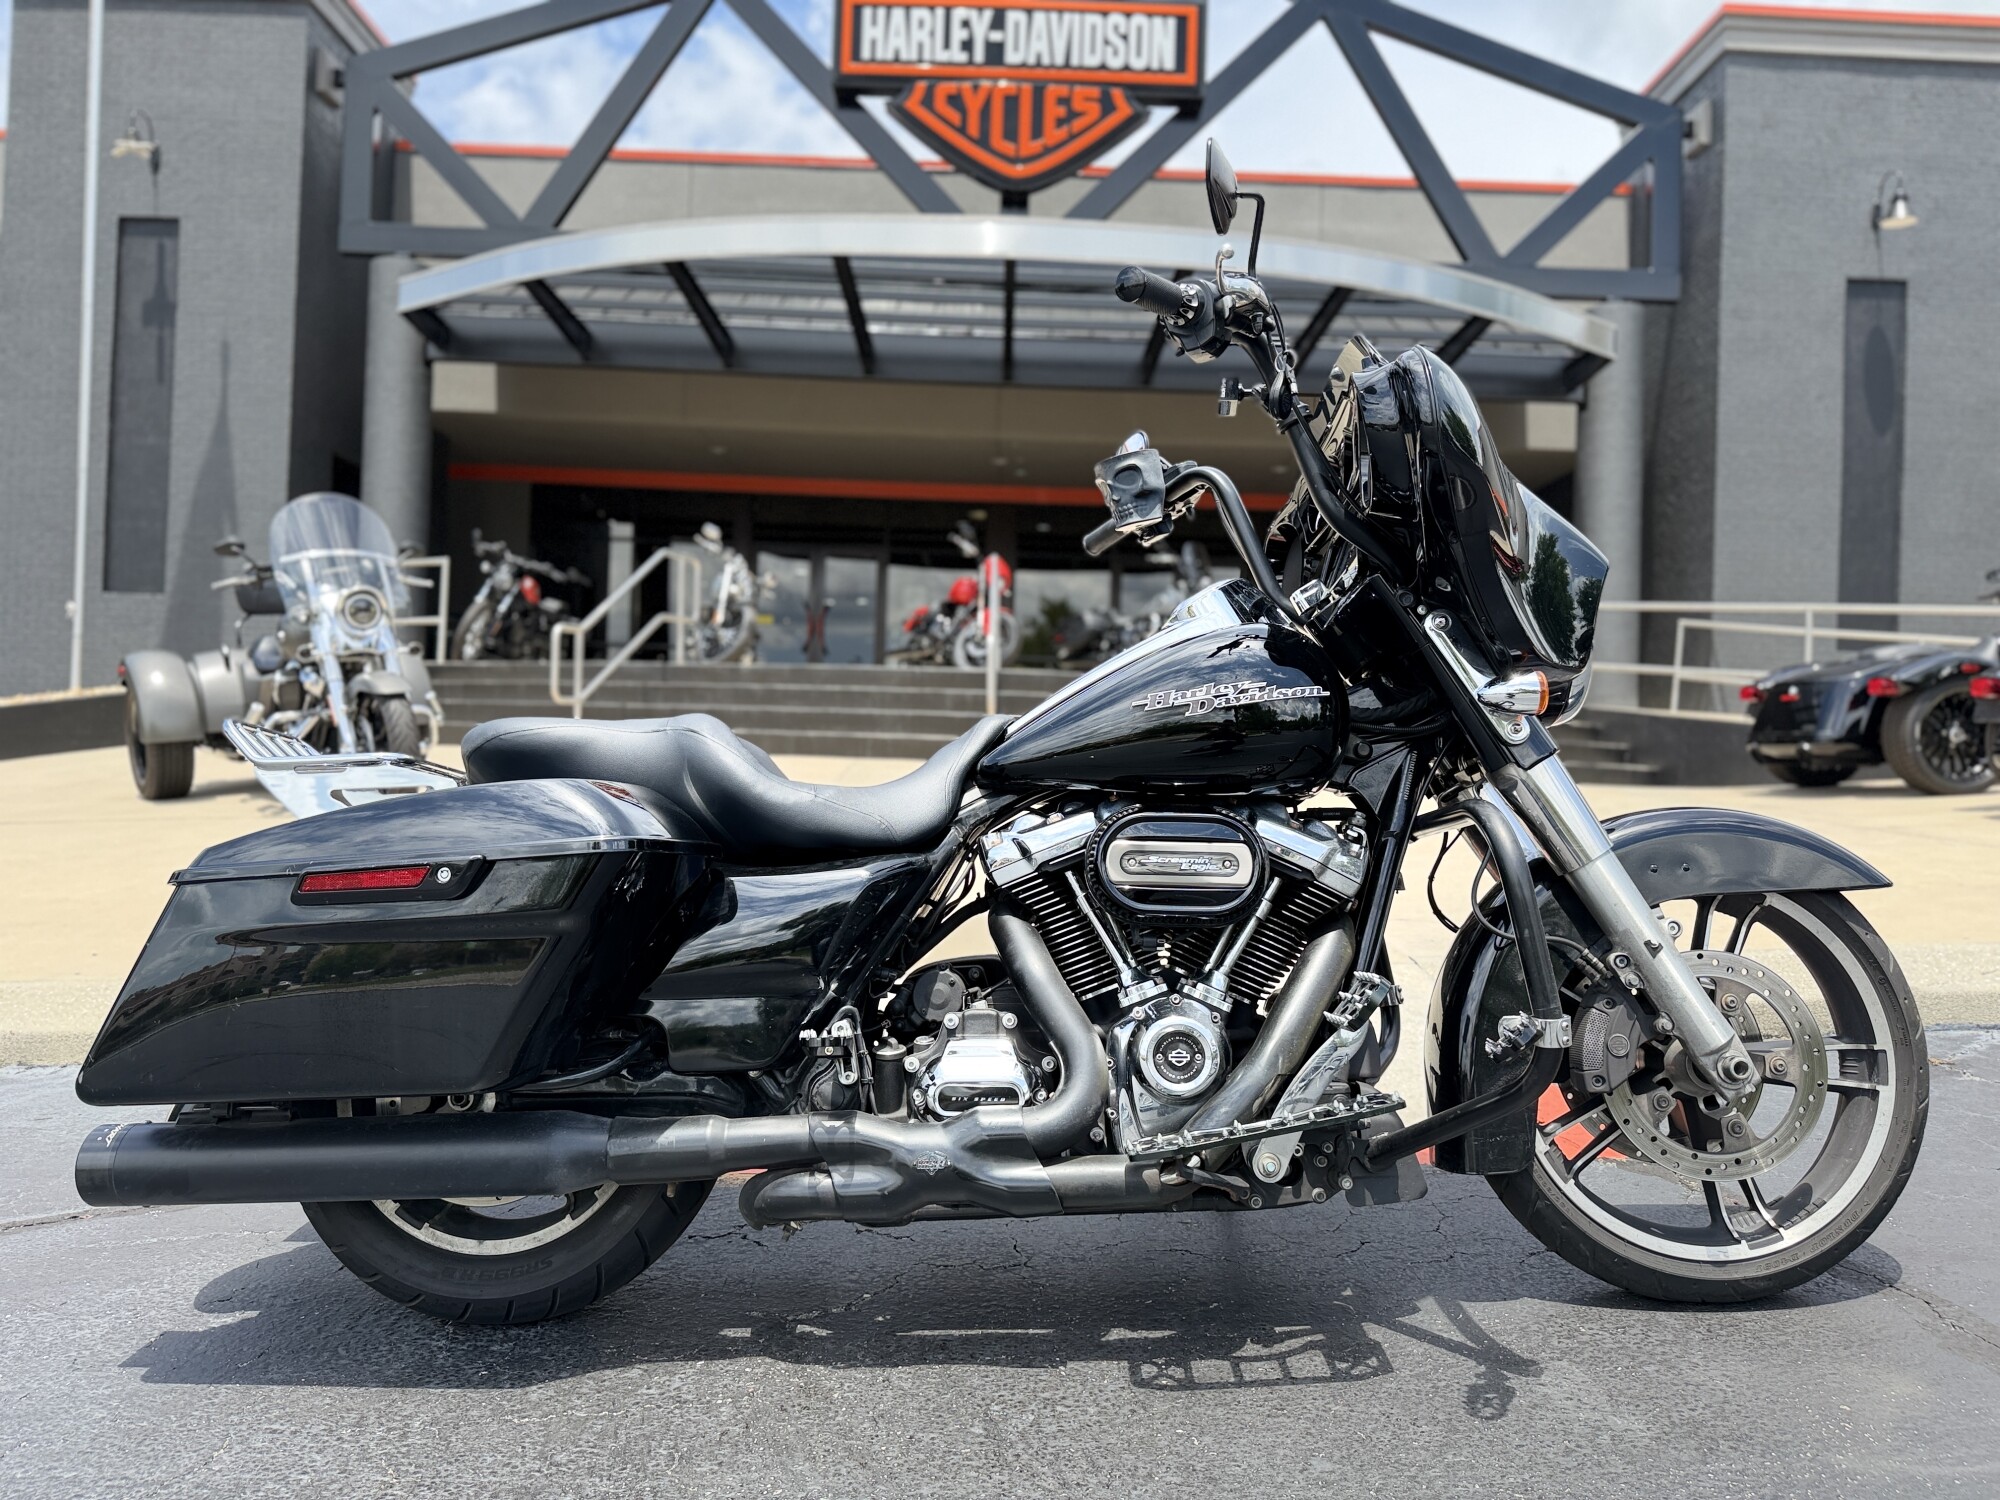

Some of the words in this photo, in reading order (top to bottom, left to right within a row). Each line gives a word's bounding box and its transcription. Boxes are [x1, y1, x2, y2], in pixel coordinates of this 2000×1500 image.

[859, 6, 1178, 71] HARLEY-DAVIDSON
[933, 81, 1101, 159] CYCLES
[1185, 685, 1331, 717] Davidson
[1180, 863, 1221, 872] Eagle
